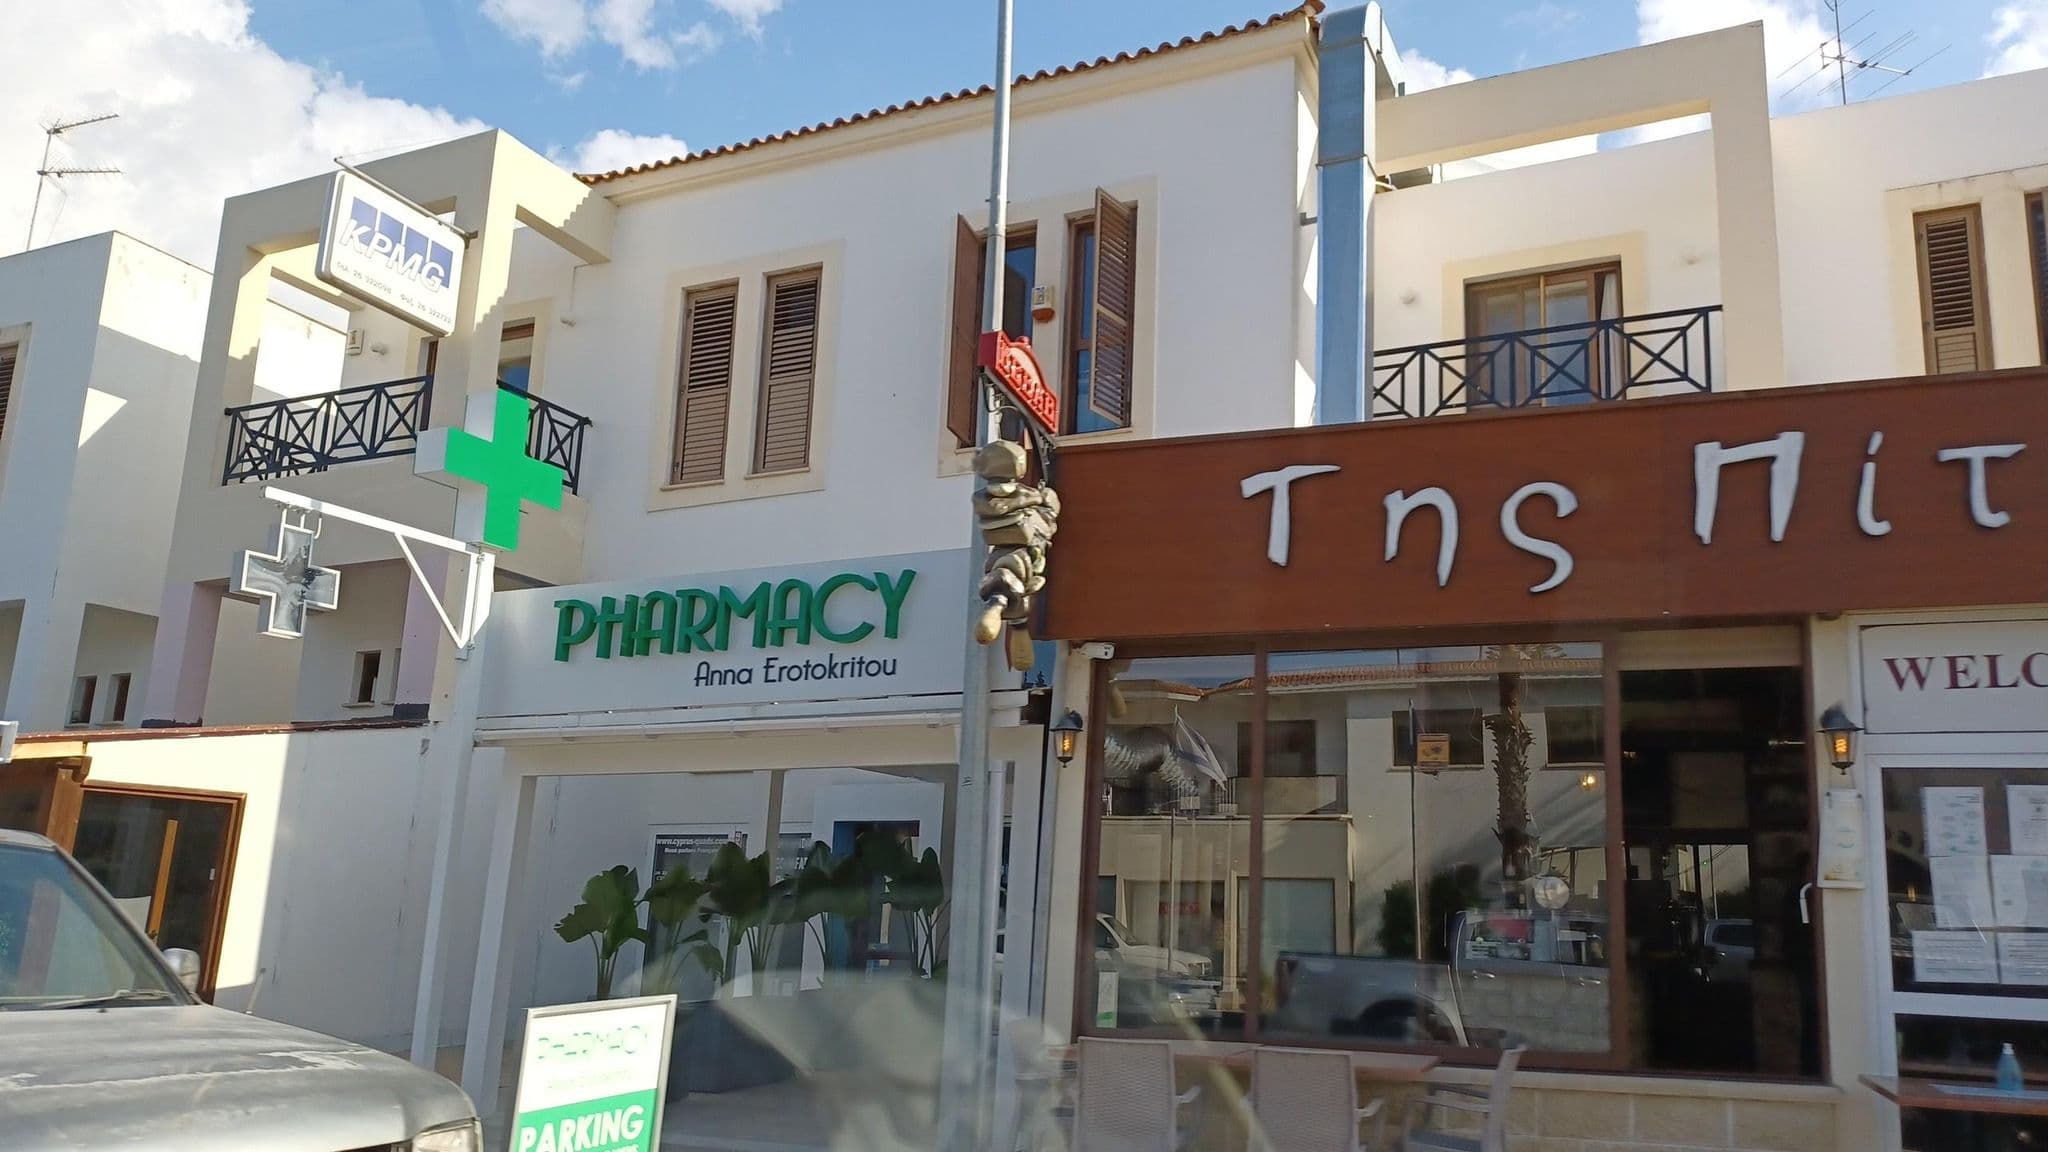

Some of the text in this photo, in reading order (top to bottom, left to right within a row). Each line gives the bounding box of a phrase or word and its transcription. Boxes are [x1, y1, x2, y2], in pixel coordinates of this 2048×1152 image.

[339, 218, 446, 294] KPMG
[1240, 464, 1579, 595] Της
[553, 568, 917, 662] PHARMACY
[693, 652, 897, 688] Anna Erotokritou
[518, 1104, 645, 1152] PARKING
